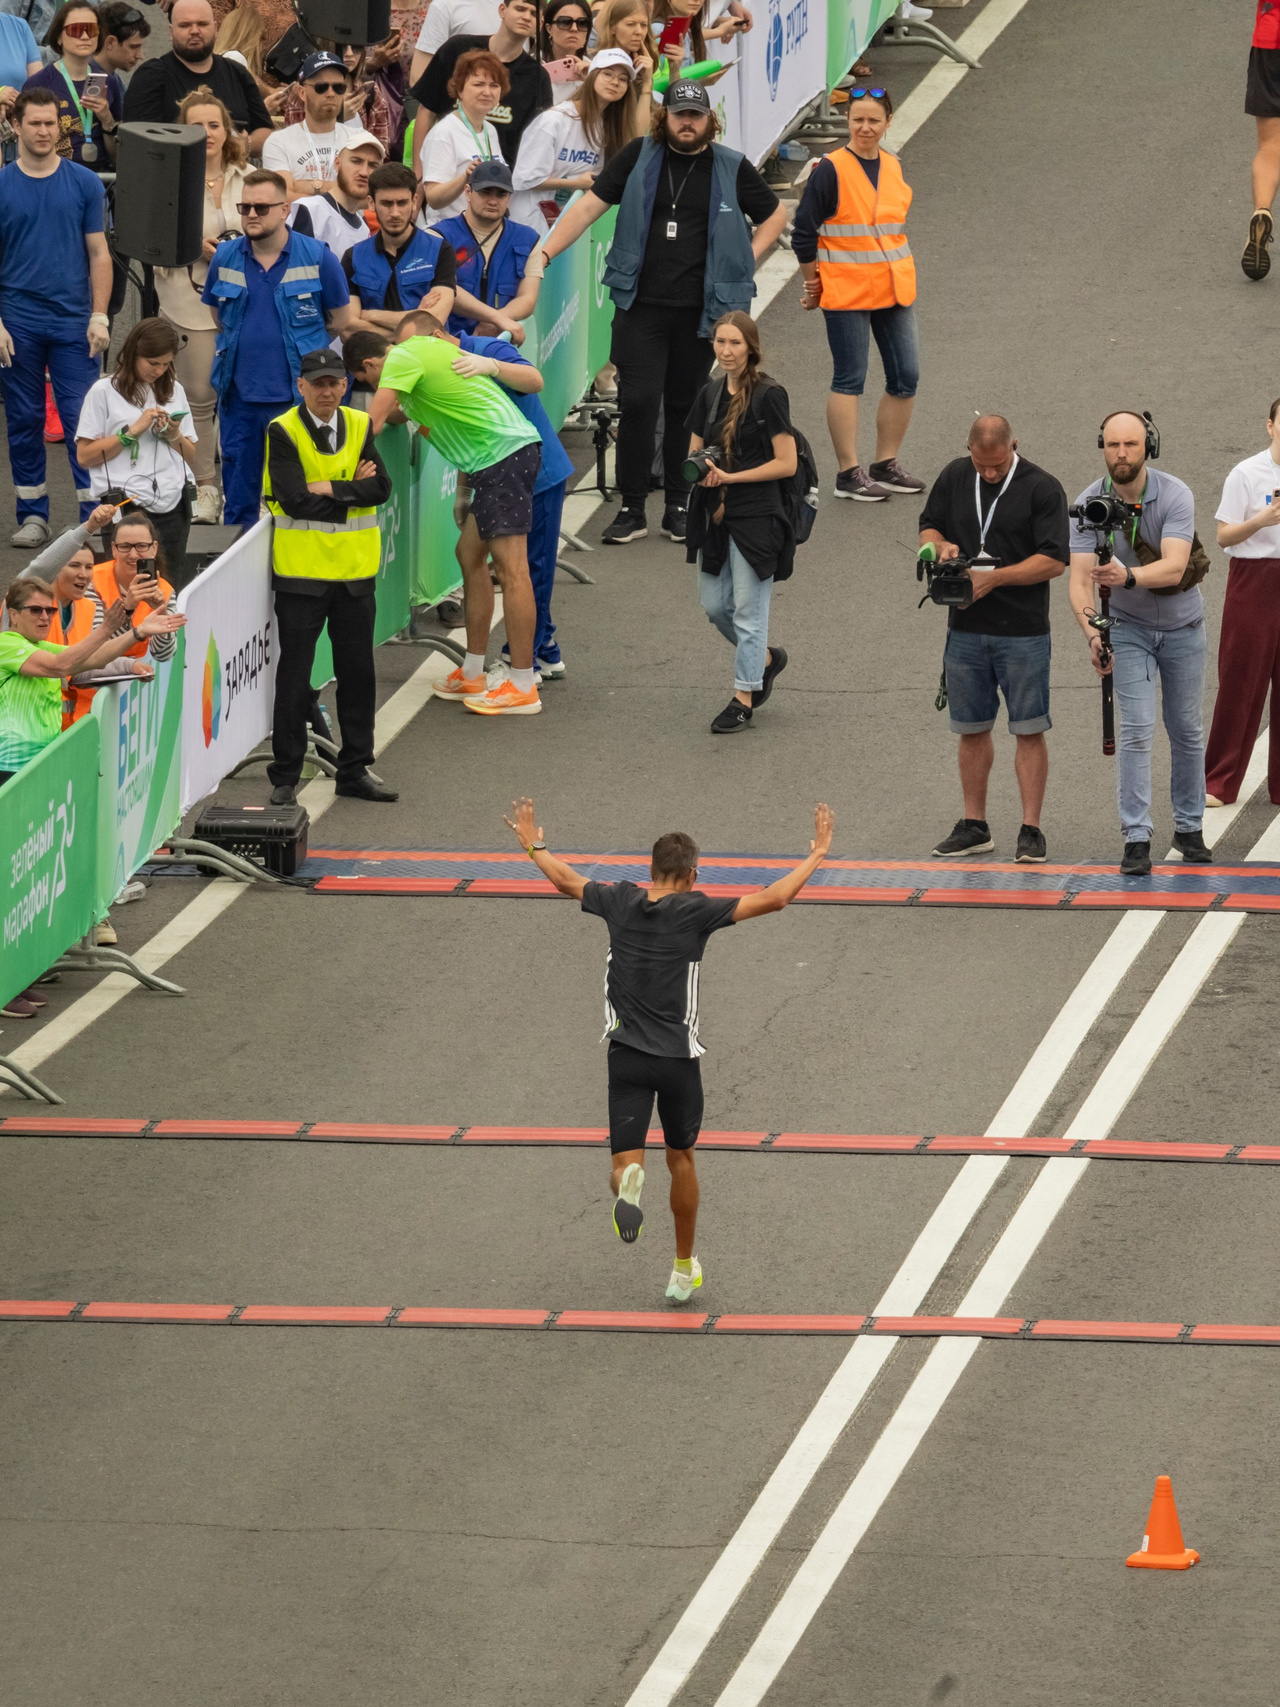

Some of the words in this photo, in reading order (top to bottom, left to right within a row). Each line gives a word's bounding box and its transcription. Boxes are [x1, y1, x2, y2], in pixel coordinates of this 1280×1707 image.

[786, 0, 808, 55] РУДН
[225, 621, 271, 722] ЗАРЯДЬЕ
[10, 799, 54, 889] зелёный
[4, 872, 49, 949] марафон
